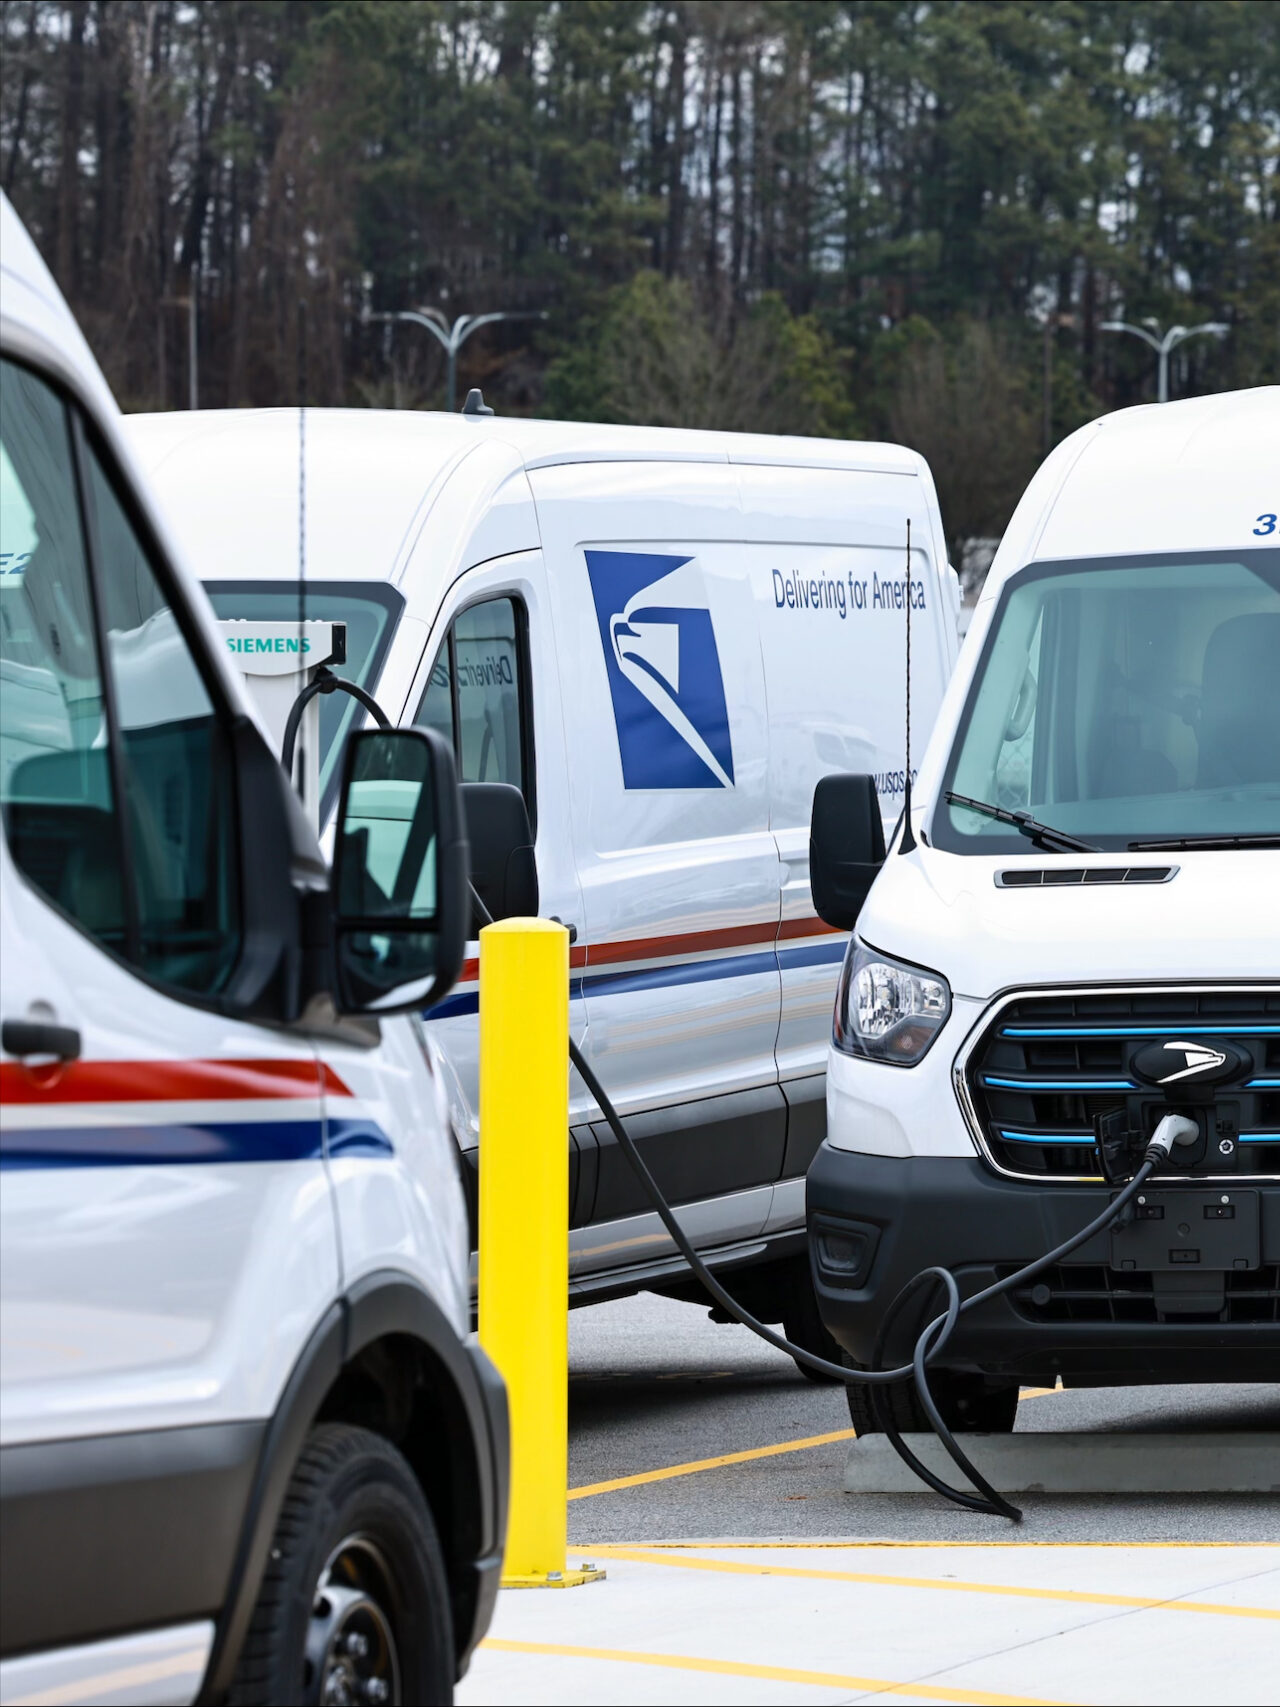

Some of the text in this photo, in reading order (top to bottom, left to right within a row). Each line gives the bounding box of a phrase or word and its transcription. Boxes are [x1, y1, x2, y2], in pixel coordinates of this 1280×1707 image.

[771, 568, 926, 620] Delivering for Amerca
[226, 637, 311, 653] SIEMENS
